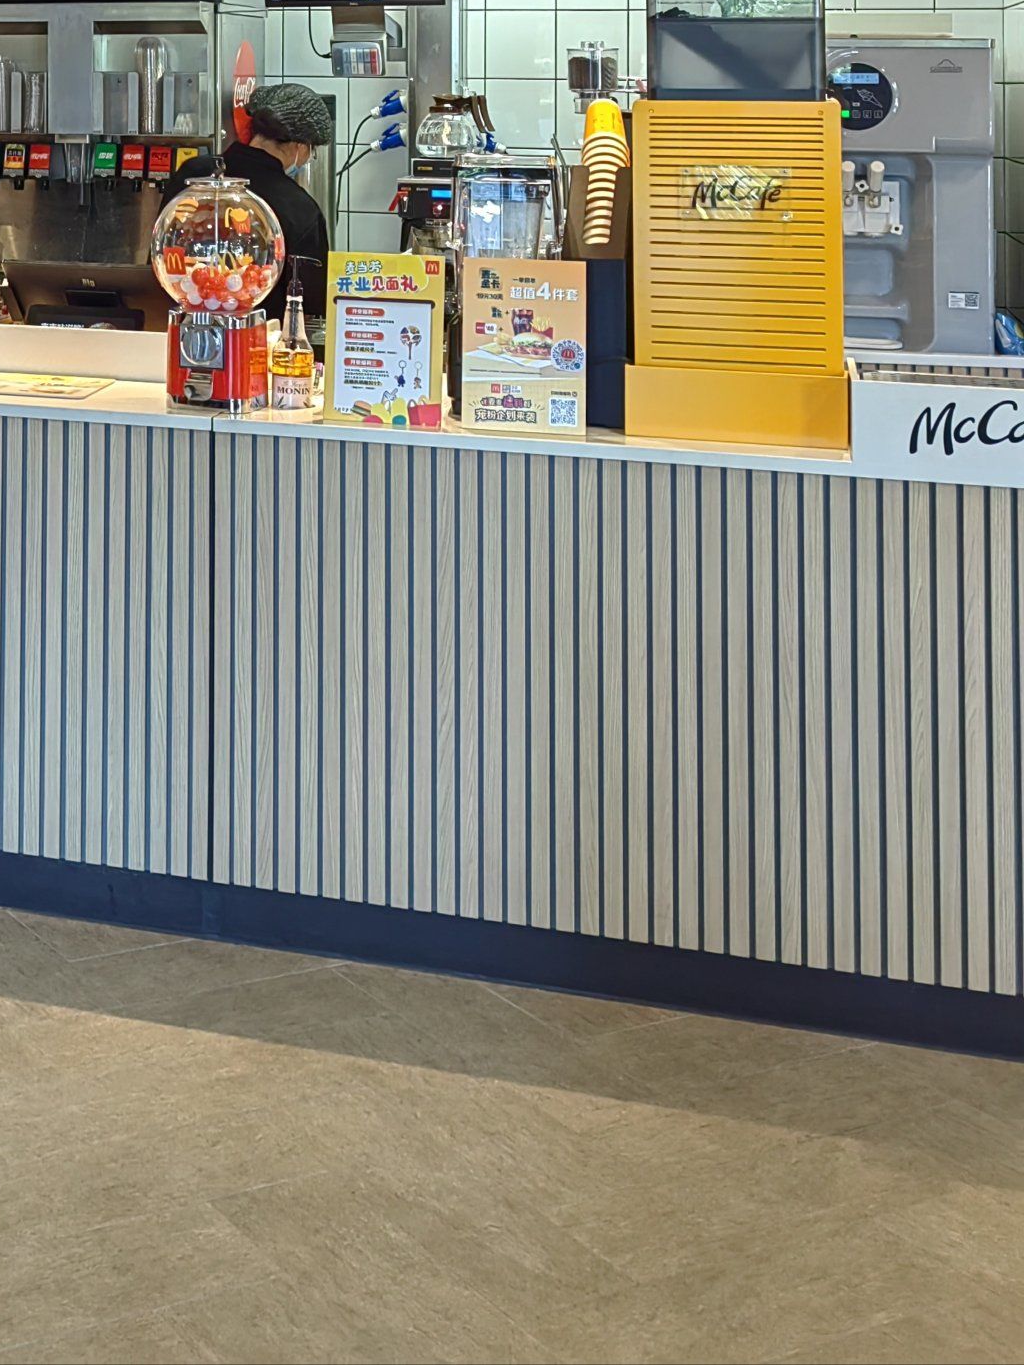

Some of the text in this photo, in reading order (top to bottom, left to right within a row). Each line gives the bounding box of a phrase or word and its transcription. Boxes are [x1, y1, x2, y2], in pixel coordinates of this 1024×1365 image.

[346, 260, 382, 275] 麦当劳
[336, 274, 418, 293] 开业见面礼
[510, 282, 579, 301] 超值4件套
[277, 386, 310, 394] MONIN
[475, 408, 537, 423] 宠粉企划来袭
